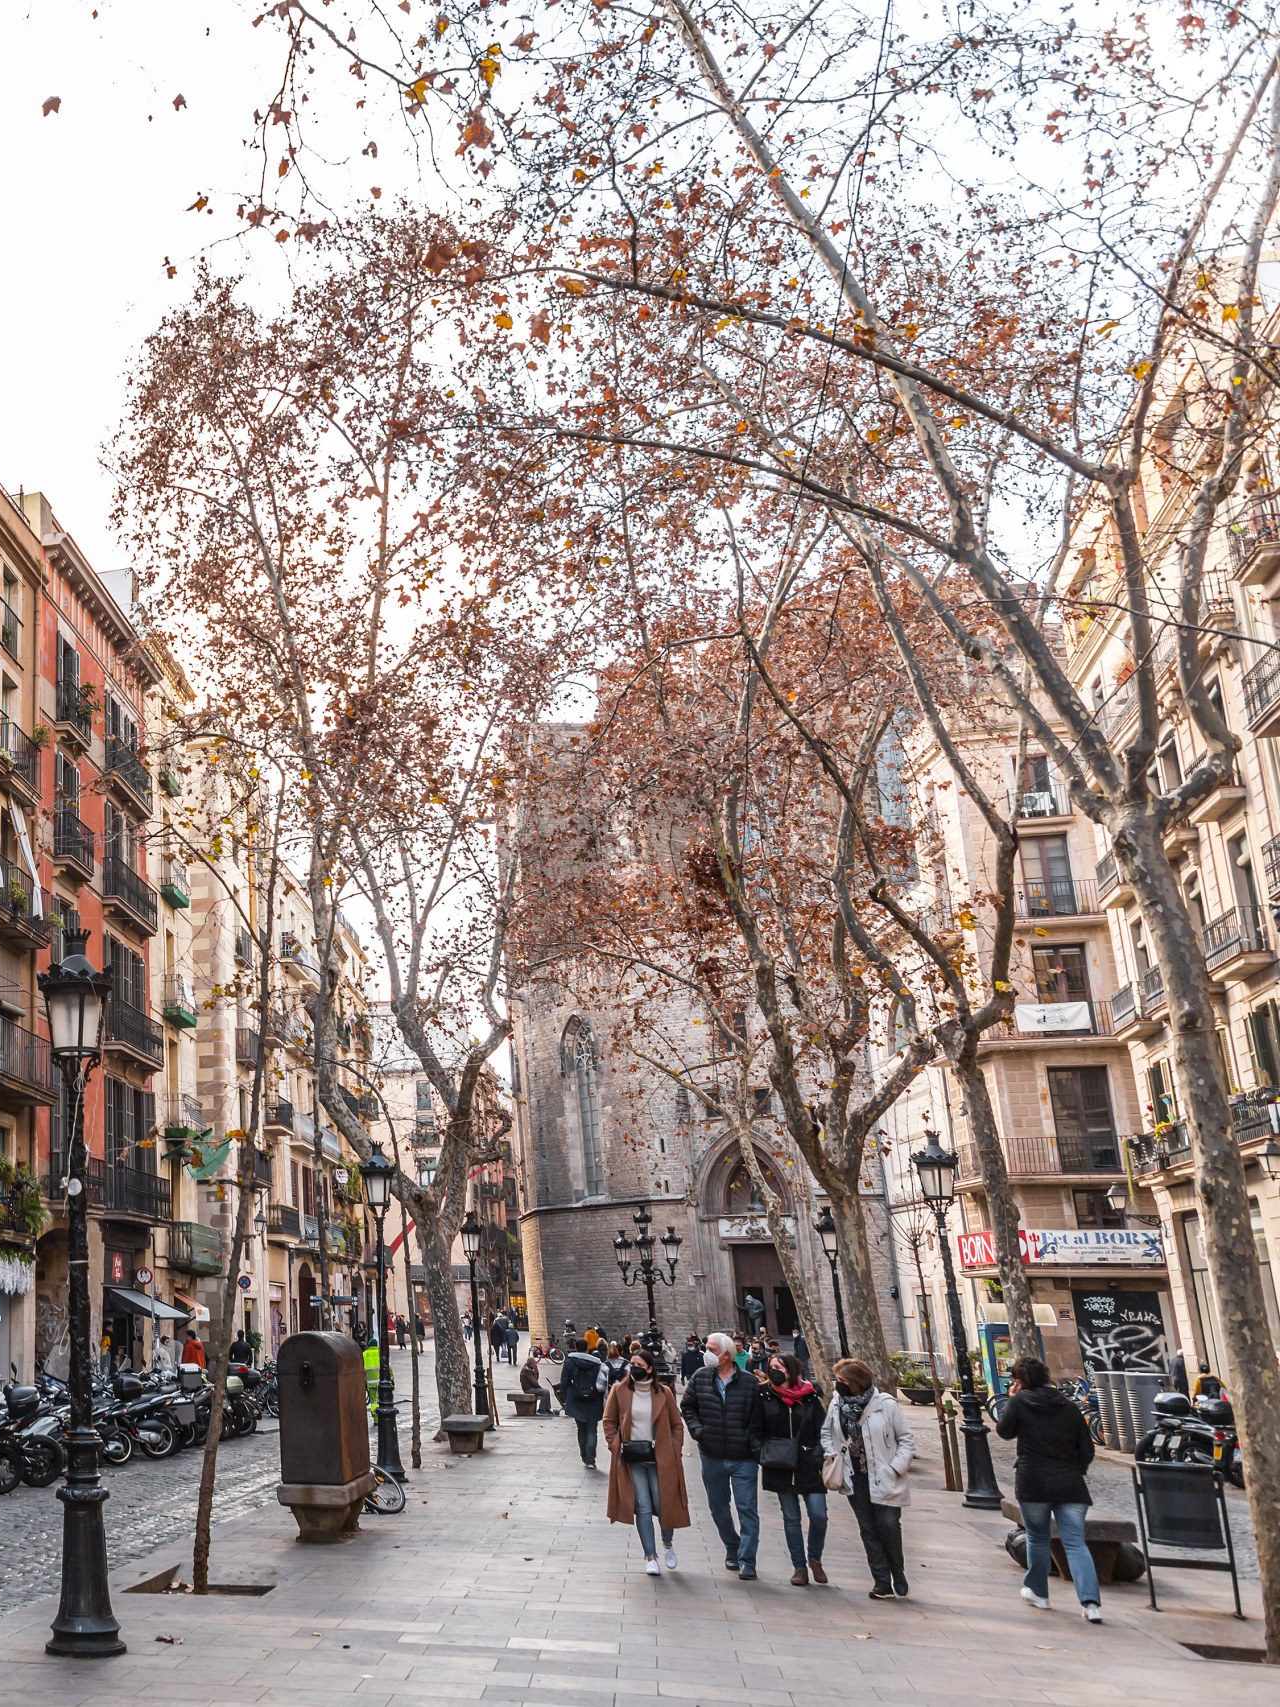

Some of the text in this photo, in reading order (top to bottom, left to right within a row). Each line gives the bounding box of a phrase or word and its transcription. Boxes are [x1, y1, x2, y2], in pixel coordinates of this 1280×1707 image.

[961, 1234, 997, 1264] BORN
[1041, 1232, 1162, 1245] Fet al BORN
